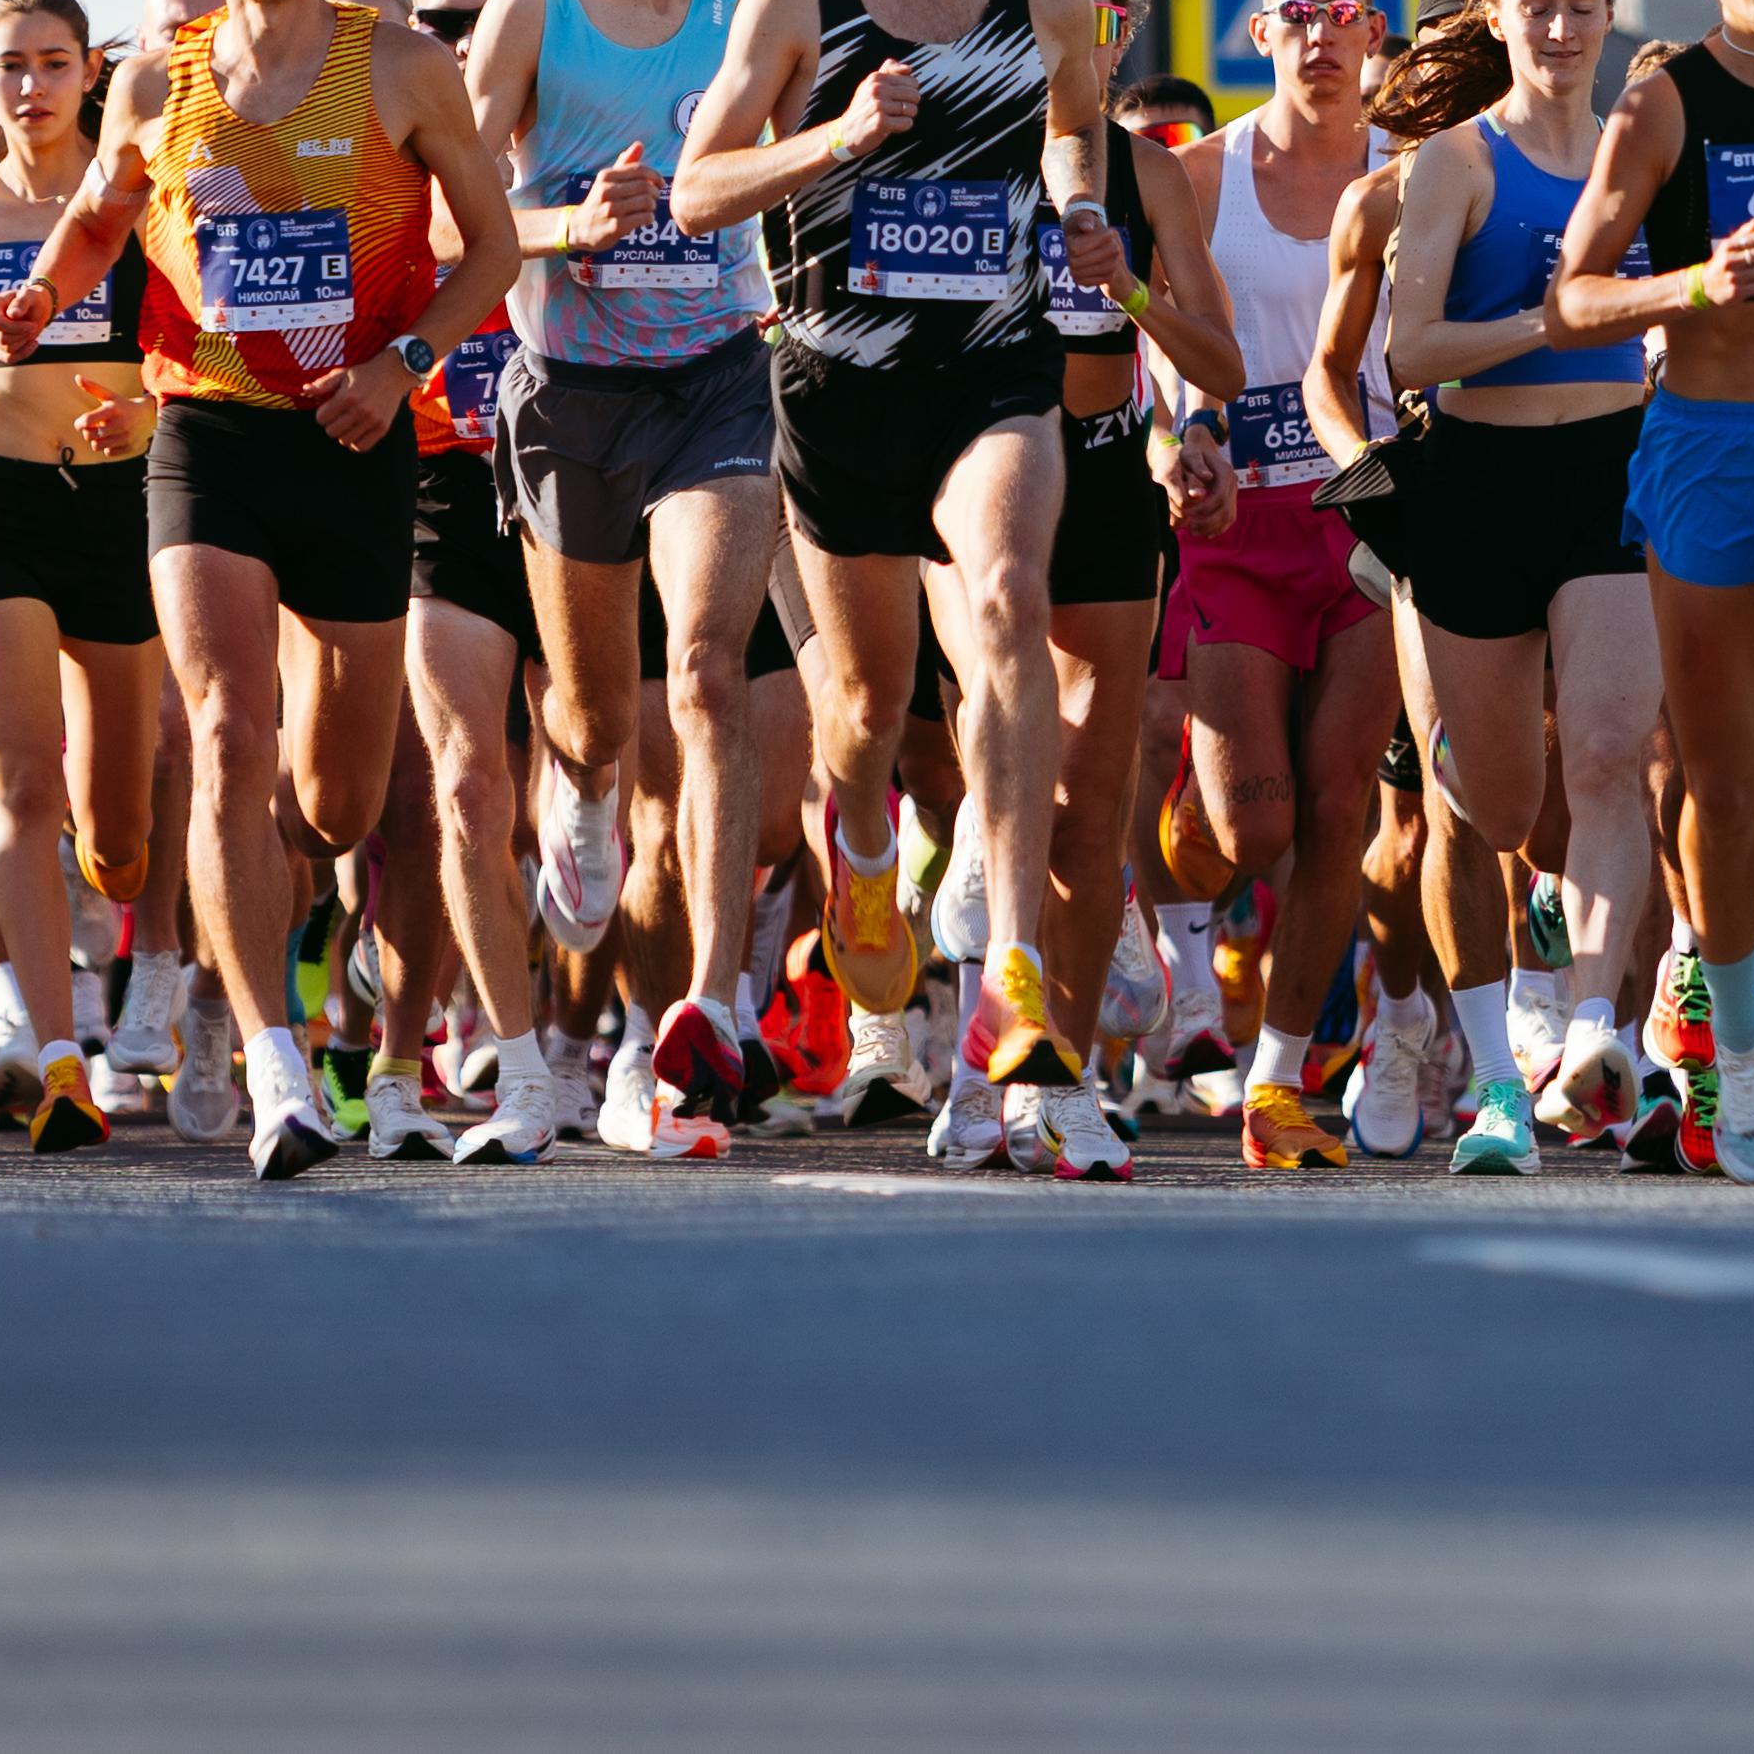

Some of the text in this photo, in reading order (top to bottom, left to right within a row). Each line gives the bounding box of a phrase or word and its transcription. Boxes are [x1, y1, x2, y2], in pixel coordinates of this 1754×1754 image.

[879, 187, 906, 201] ВТБ
[216, 223, 239, 237] ВТБ
[865, 221, 973, 255] 18020
[613, 250, 664, 261] РУСЛАН
[229, 256, 305, 287] 7427
[238, 287, 300, 303] НИКОЛАЙ
[460, 342, 484, 354] ВТБ
[476, 372, 502, 399] 7
[1247, 395, 1271, 408] ВТБ
[1264, 420, 1317, 448] 652
[714, 456, 763, 469] INSANITY
